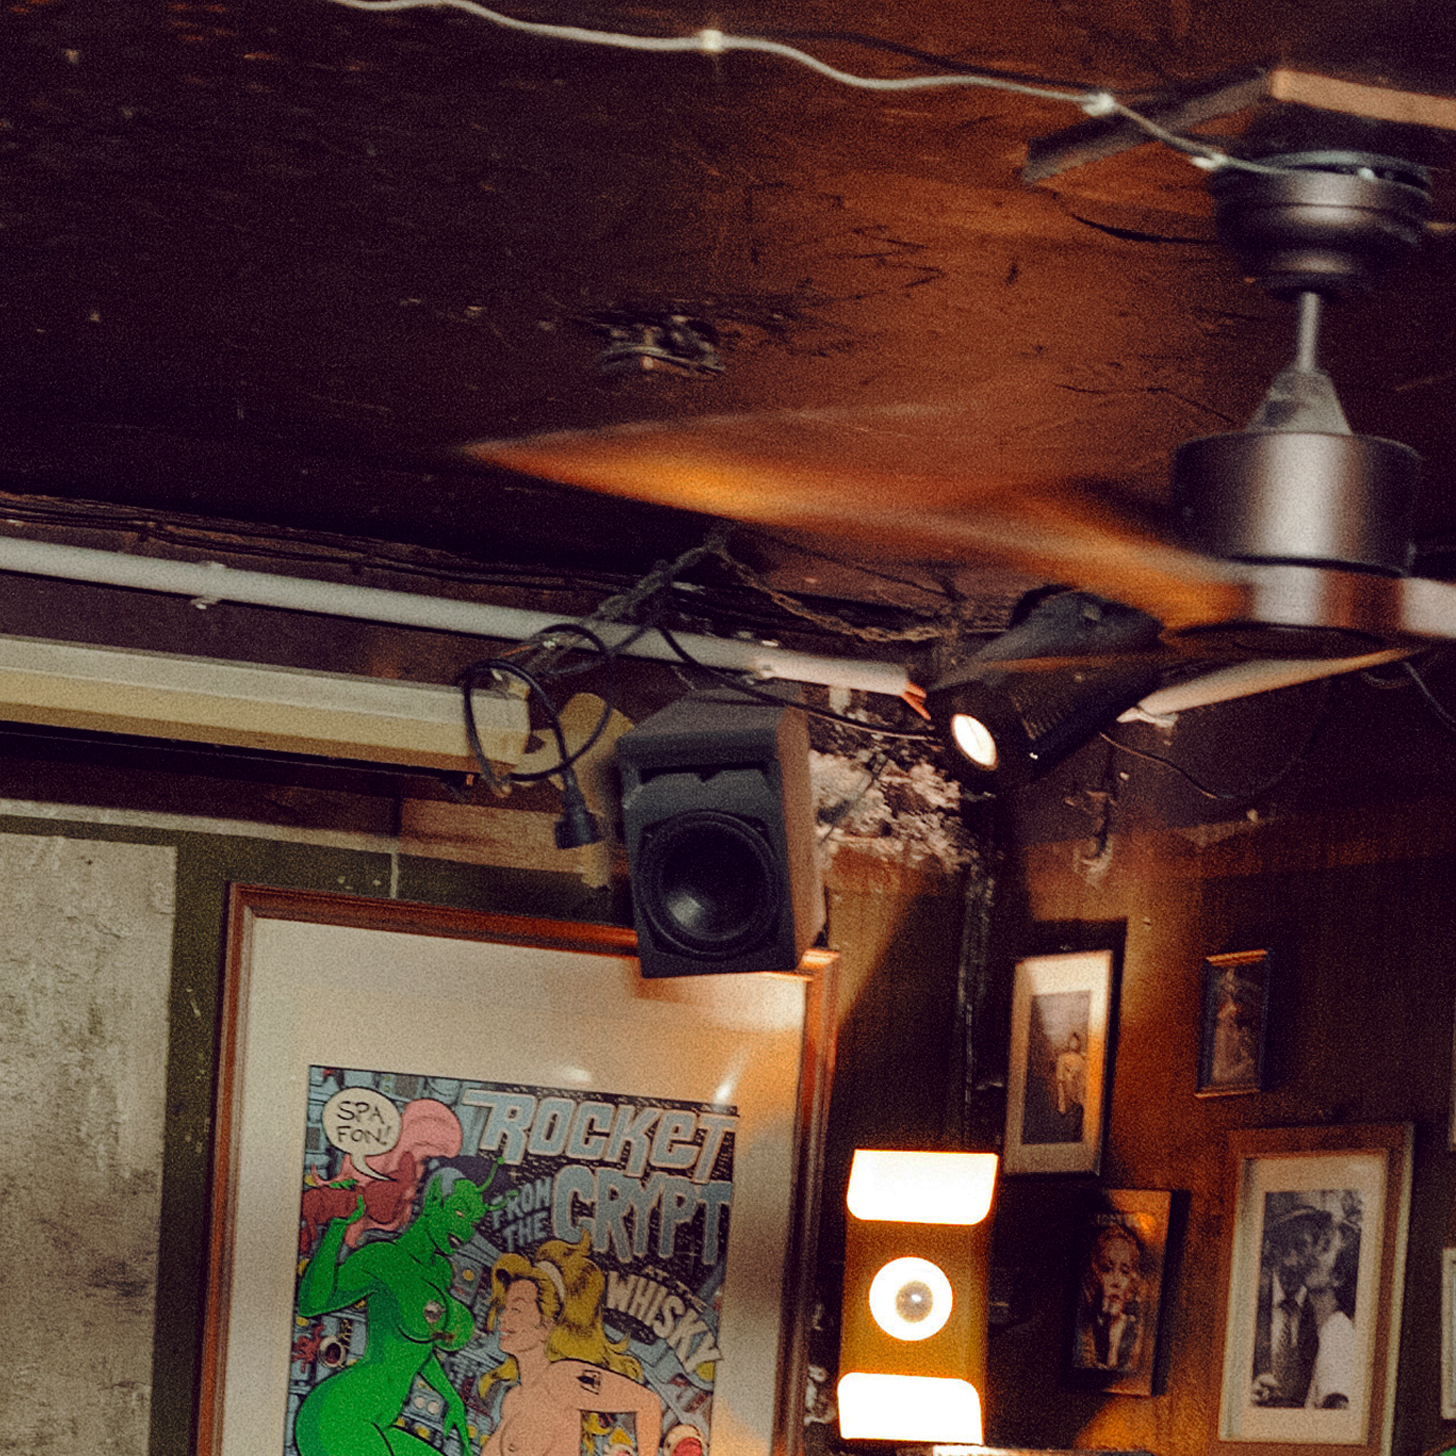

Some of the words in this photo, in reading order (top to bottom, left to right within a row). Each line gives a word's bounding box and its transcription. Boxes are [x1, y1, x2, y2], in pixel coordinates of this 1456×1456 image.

[337, 1100, 385, 1124] SPA
[461, 1087, 740, 1184] ROCKET
[491, 1176, 552, 1231] FROM
[503, 1210, 549, 1252] THE
[552, 1164, 733, 1265] CRYPT
[606, 1271, 724, 1374] WHISKY
